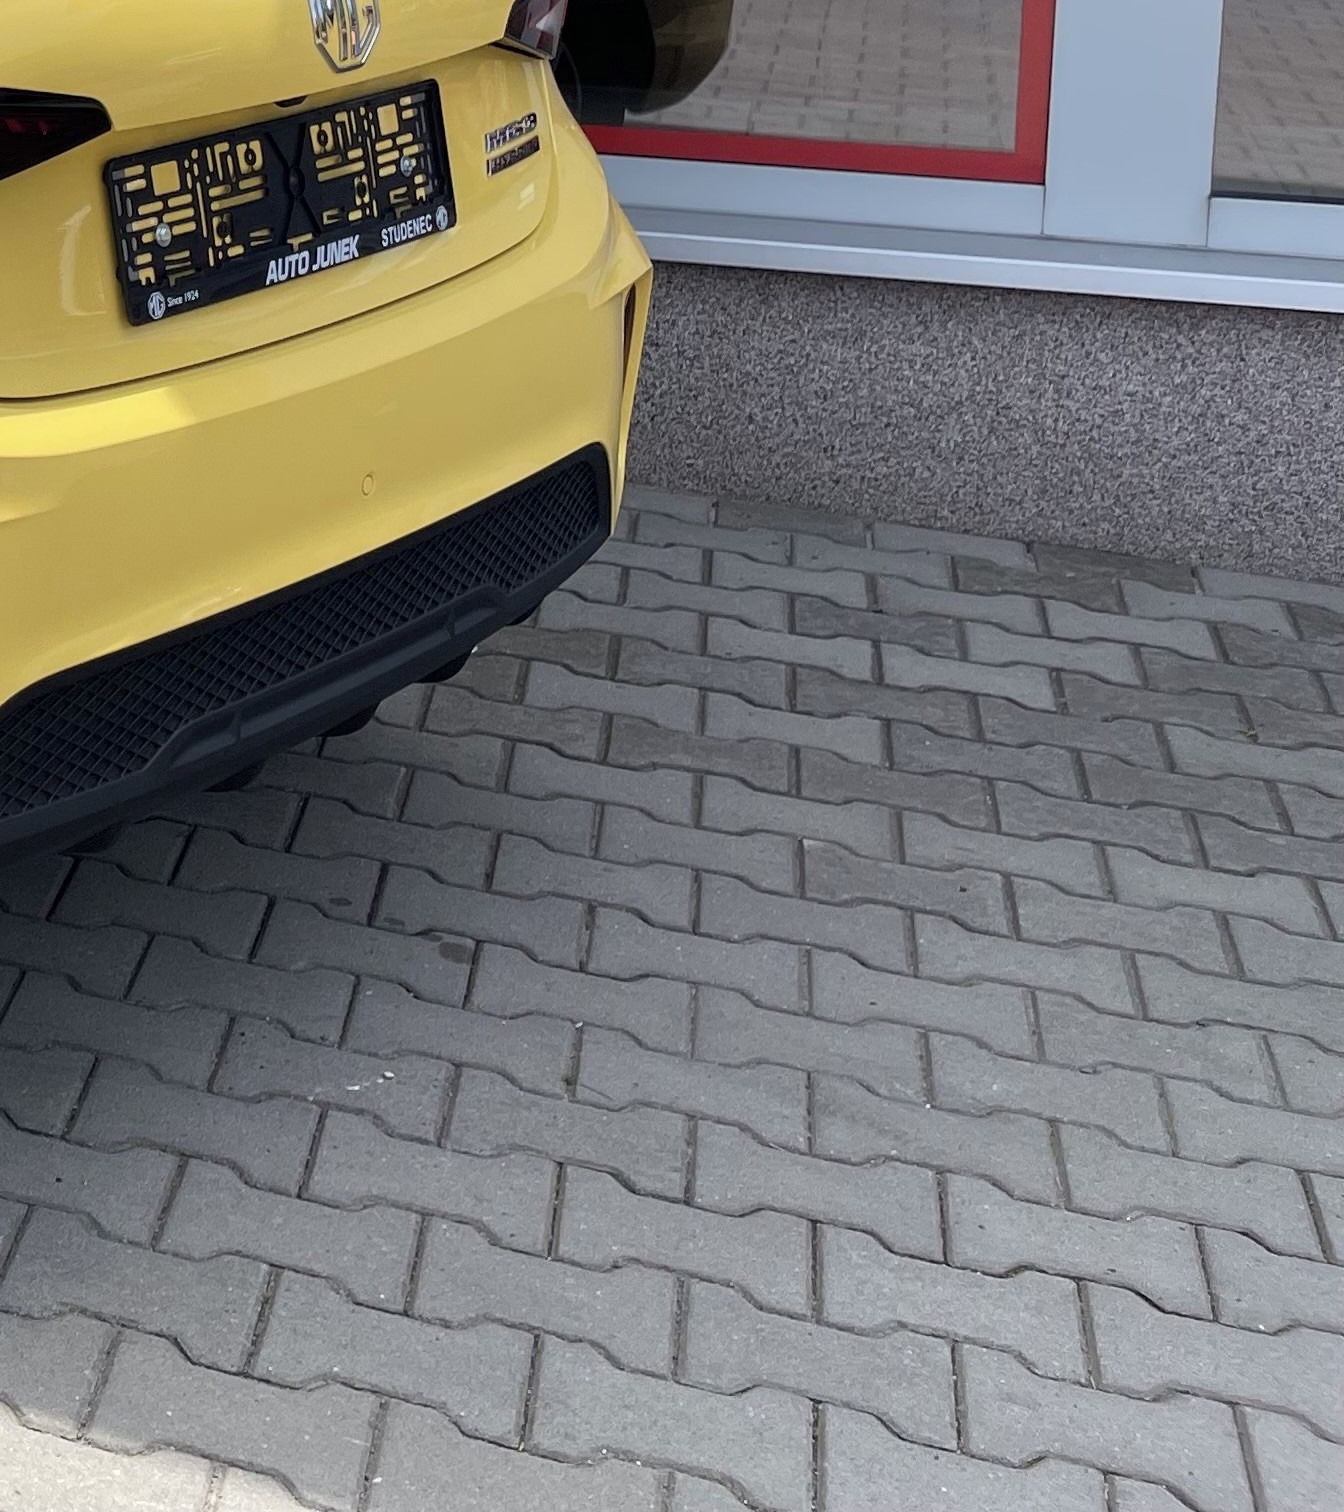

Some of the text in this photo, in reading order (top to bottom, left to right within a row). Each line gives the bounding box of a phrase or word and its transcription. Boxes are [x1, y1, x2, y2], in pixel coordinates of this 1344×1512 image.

[381, 214, 433, 247] STUDENEC
[265, 234, 360, 286] AUTO JUNEK
[148, 289, 199, 319] MG Since 1924
